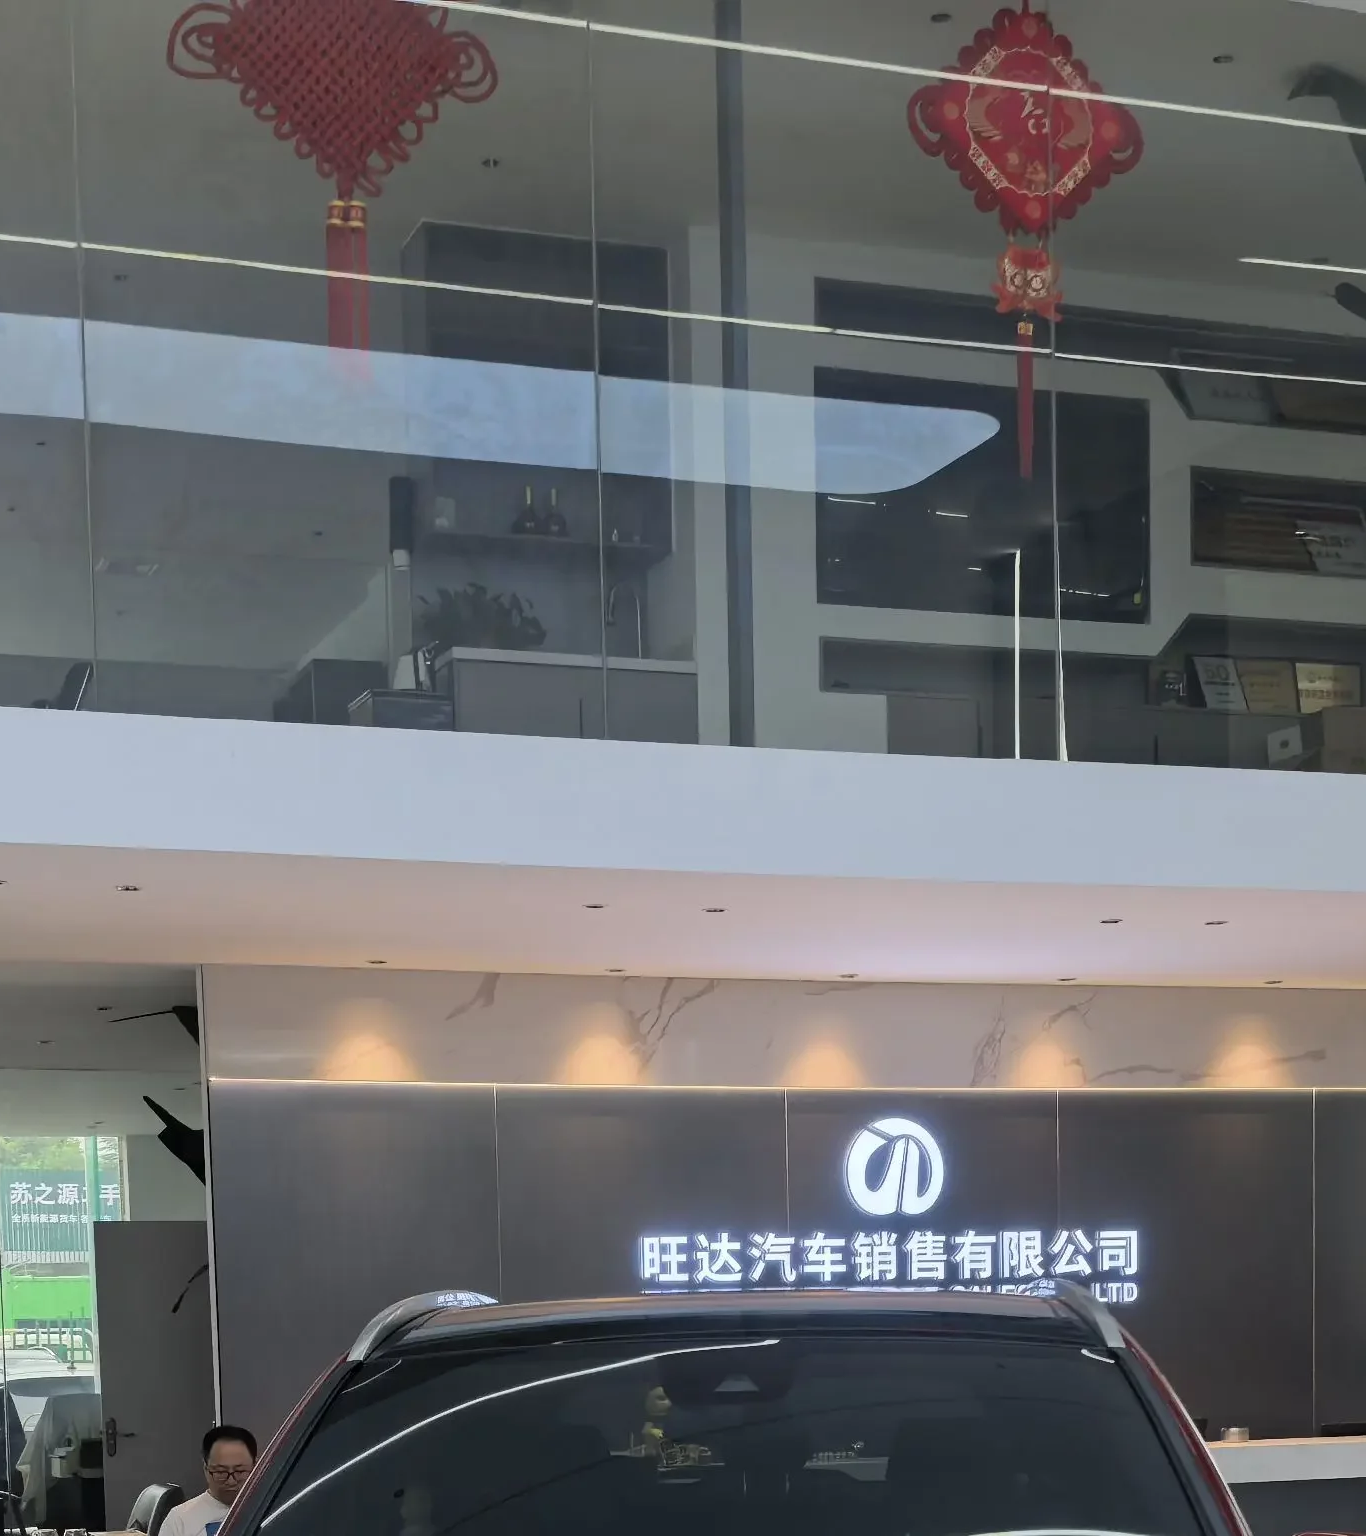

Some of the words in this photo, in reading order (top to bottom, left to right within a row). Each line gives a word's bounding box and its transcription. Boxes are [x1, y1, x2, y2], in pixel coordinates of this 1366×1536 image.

[9, 1181, 120, 1206] 苏之源手
[640, 1229, 1138, 1284] 旺达汽车销售有限公司
[1093, 1282, 1138, 1303] LTD
